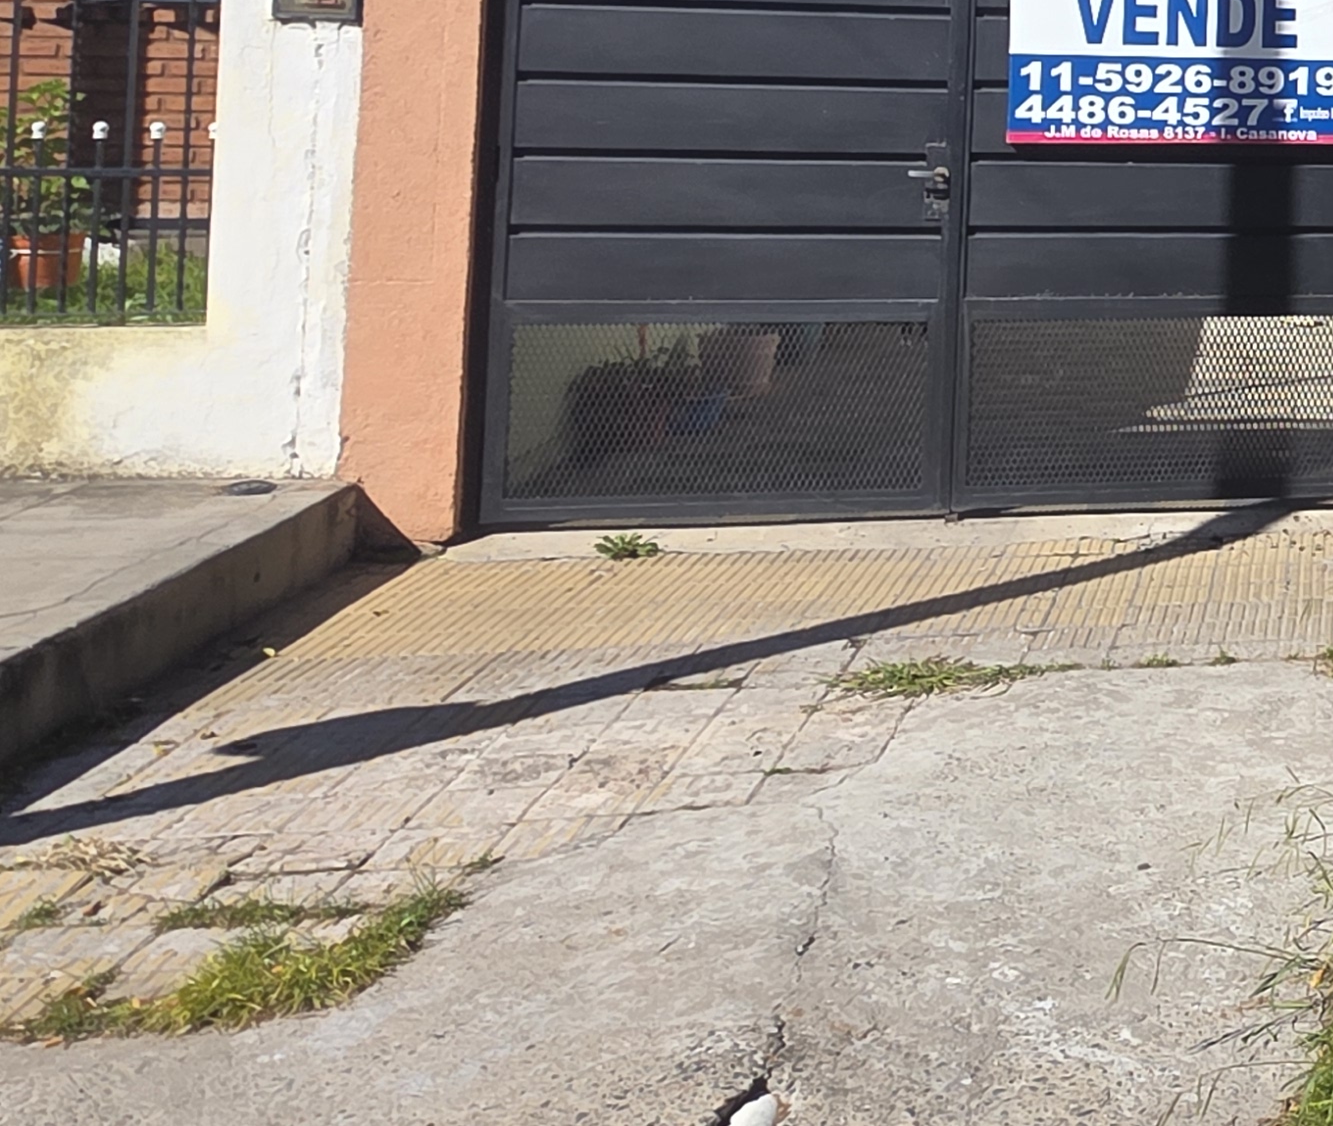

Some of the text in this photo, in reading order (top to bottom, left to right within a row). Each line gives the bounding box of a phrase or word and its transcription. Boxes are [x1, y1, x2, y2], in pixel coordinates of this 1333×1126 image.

[1015, 95, 1269, 126] 4486-4527
[1082, 125, 1102, 139] de
[1107, 126, 1159, 140] Rosas
[1163, 126, 1206, 141] 8137
[1236, 128, 1317, 141] Casanova
